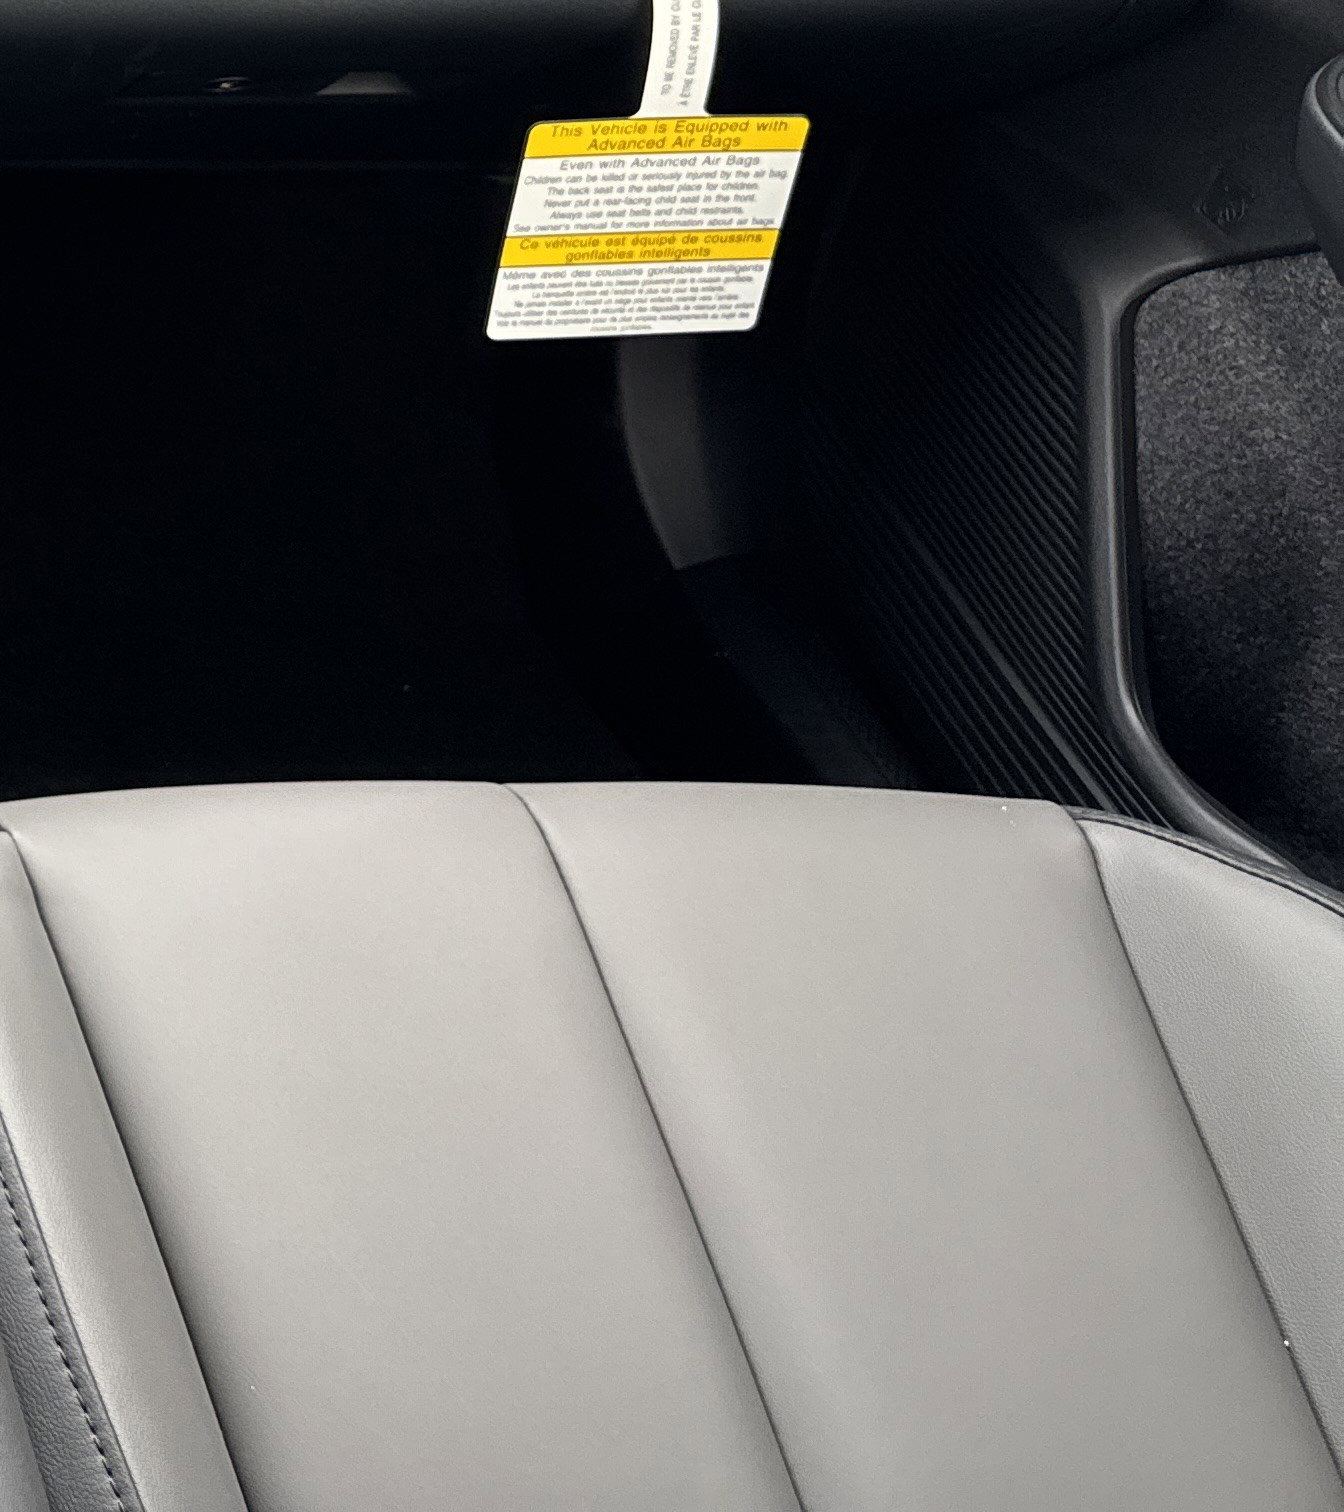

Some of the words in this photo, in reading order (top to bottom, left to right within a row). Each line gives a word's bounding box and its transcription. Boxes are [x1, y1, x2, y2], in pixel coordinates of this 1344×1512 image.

[551, 124, 583, 138] This
[590, 122, 648, 136] Vehicle
[653, 120, 668, 134] is
[673, 119, 751, 139] Equipped
[755, 119, 789, 133] with
[586, 137, 666, 152] Advanced
[671, 136, 695, 149] Air
[700, 134, 743, 152] Bags
[559, 159, 594, 172] Even
[598, 158, 626, 170] with
[630, 156, 698, 170] Advanced
[701, 155, 722, 166] Air
[725, 154, 761, 168] Bags
[519, 237, 540, 250] Ce
[605, 236, 627, 247] est
[681, 233, 700, 245] de
[703, 232, 764, 244] coussins
[565, 249, 635, 264] gonflables
[639, 246, 712, 260] intelligents
